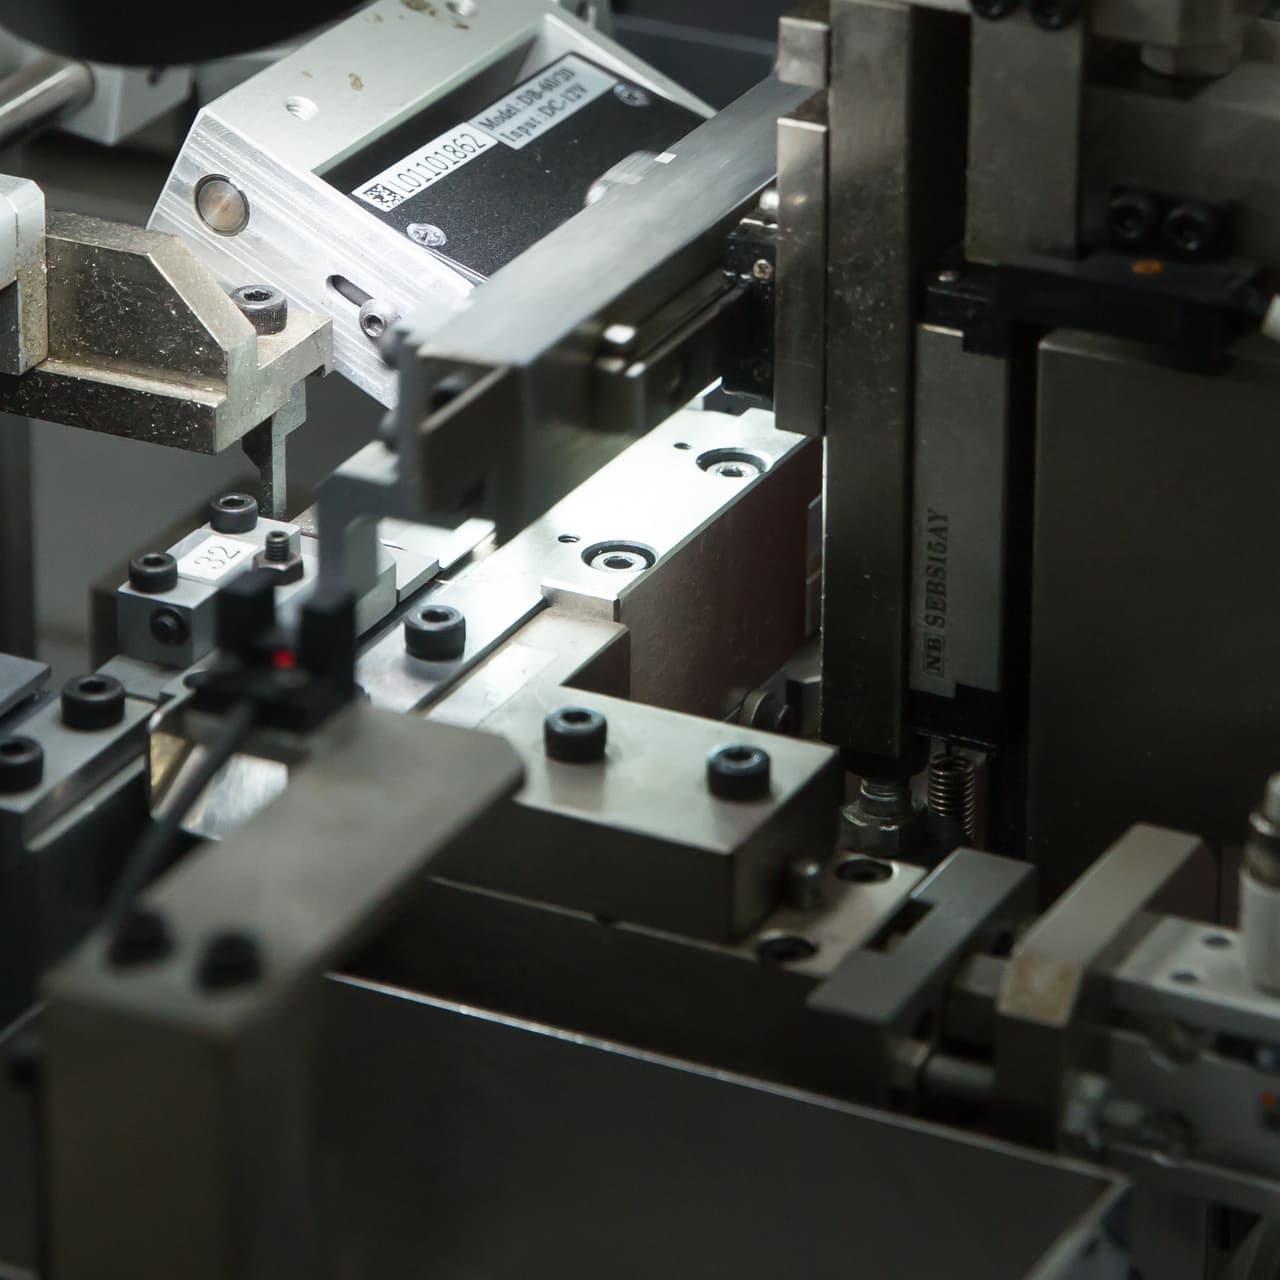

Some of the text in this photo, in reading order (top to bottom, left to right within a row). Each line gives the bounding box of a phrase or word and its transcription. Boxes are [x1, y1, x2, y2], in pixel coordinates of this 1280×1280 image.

[387, 132, 488, 194] L01101862
[194, 543, 242, 571] 32
[924, 508, 949, 672] NB SEBS15AY
